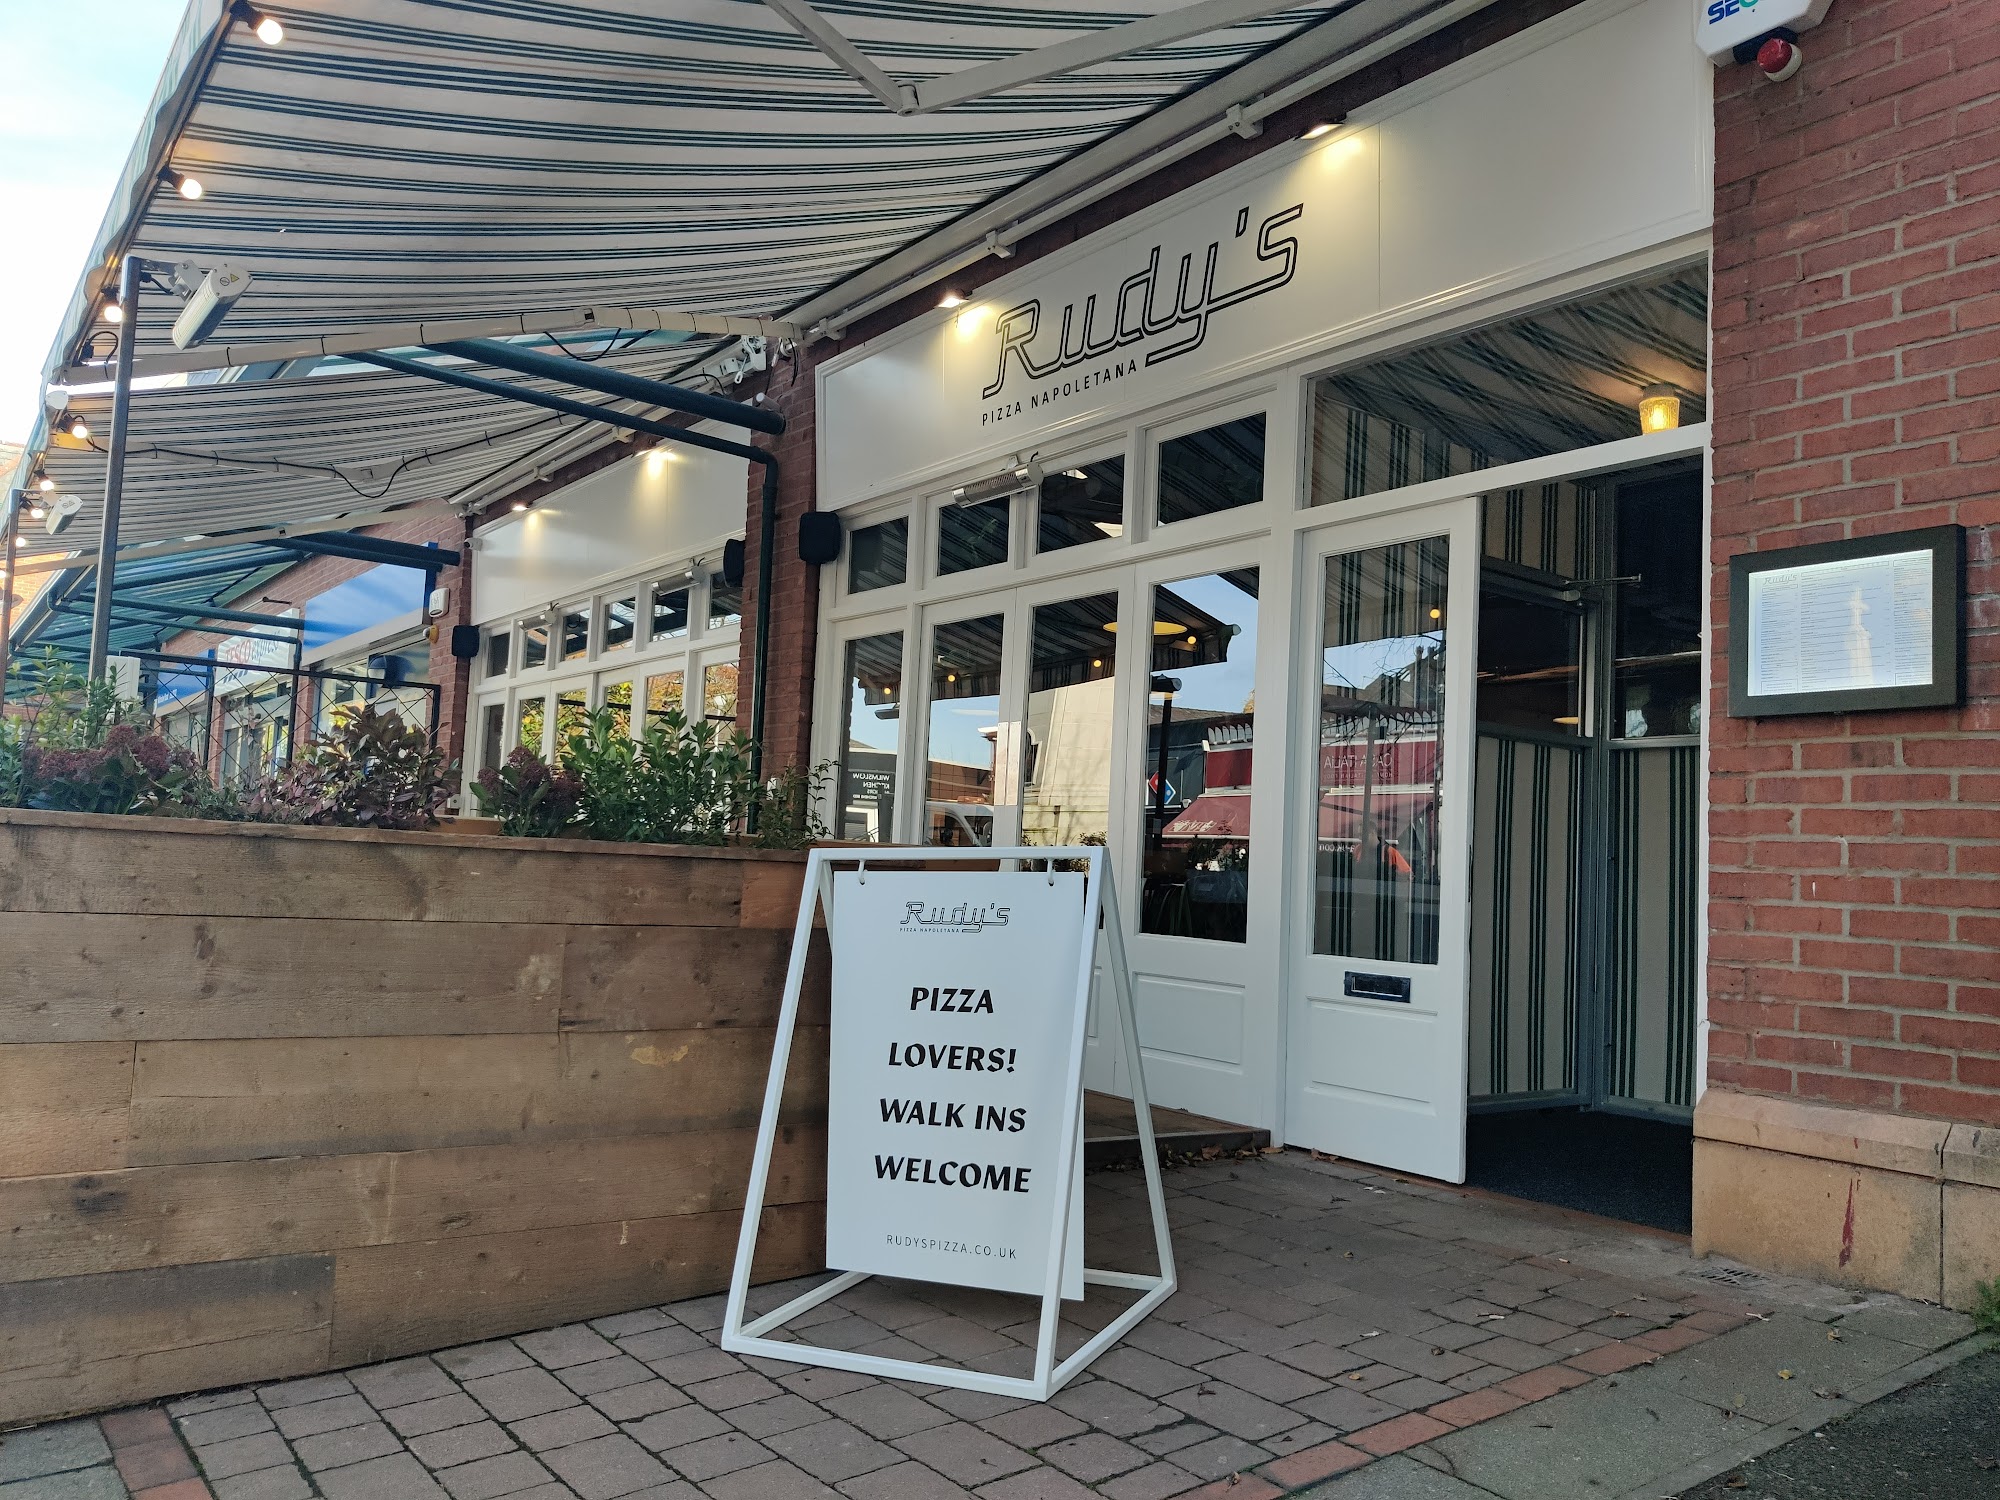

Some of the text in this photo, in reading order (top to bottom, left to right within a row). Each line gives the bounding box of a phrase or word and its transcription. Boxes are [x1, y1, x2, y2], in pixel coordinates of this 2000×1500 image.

[982, 203, 1304, 399] Rudy's
[982, 359, 1137, 426] PIZZA NAPOLETANA
[900, 901, 1011, 933] Rudy's
[910, 987, 994, 1014] PIZZA
[888, 1042, 1017, 1073] LOVERS!
[880, 1098, 1027, 1132] WALK INS
[875, 1154, 1032, 1193] WELCOME
[886, 1234, 1017, 1260] RUDYSPIZZA.CO.UK
